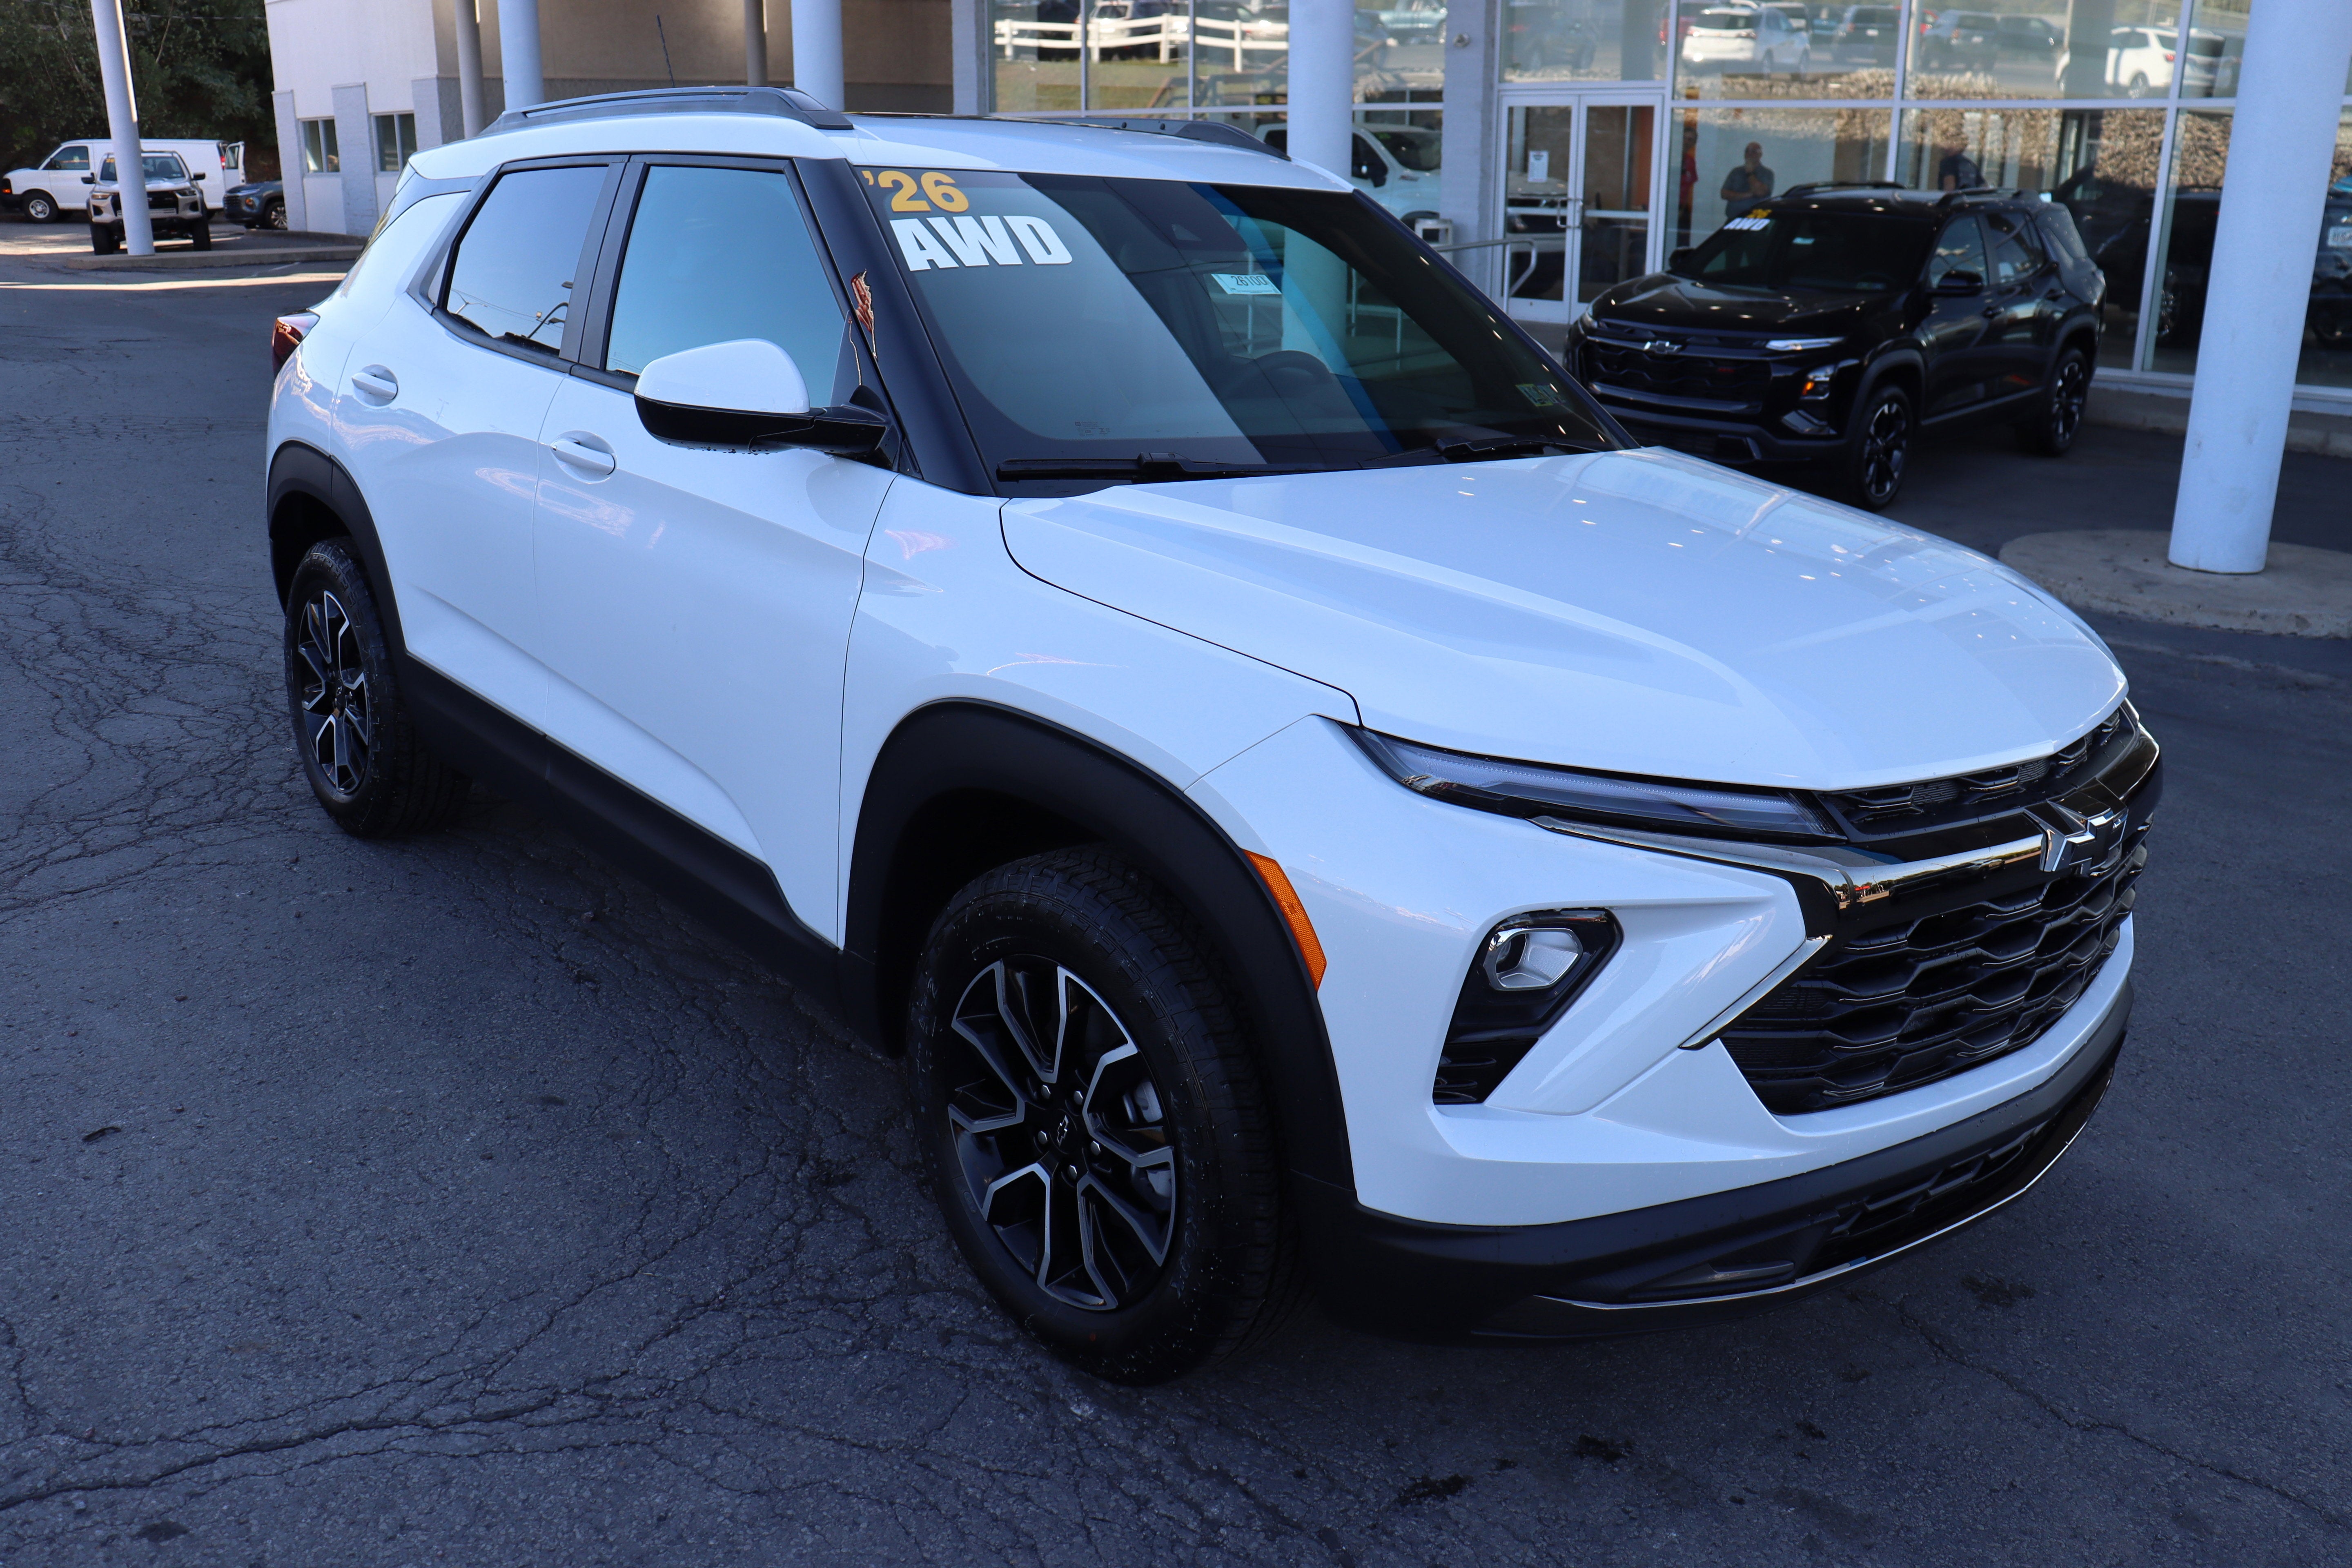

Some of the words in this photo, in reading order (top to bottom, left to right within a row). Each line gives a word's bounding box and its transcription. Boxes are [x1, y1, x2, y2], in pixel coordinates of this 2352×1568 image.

[1723, 217, 1771, 231] AWD
[889, 215, 1073, 272] AWD
[1231, 276, 1267, 286] 26100
